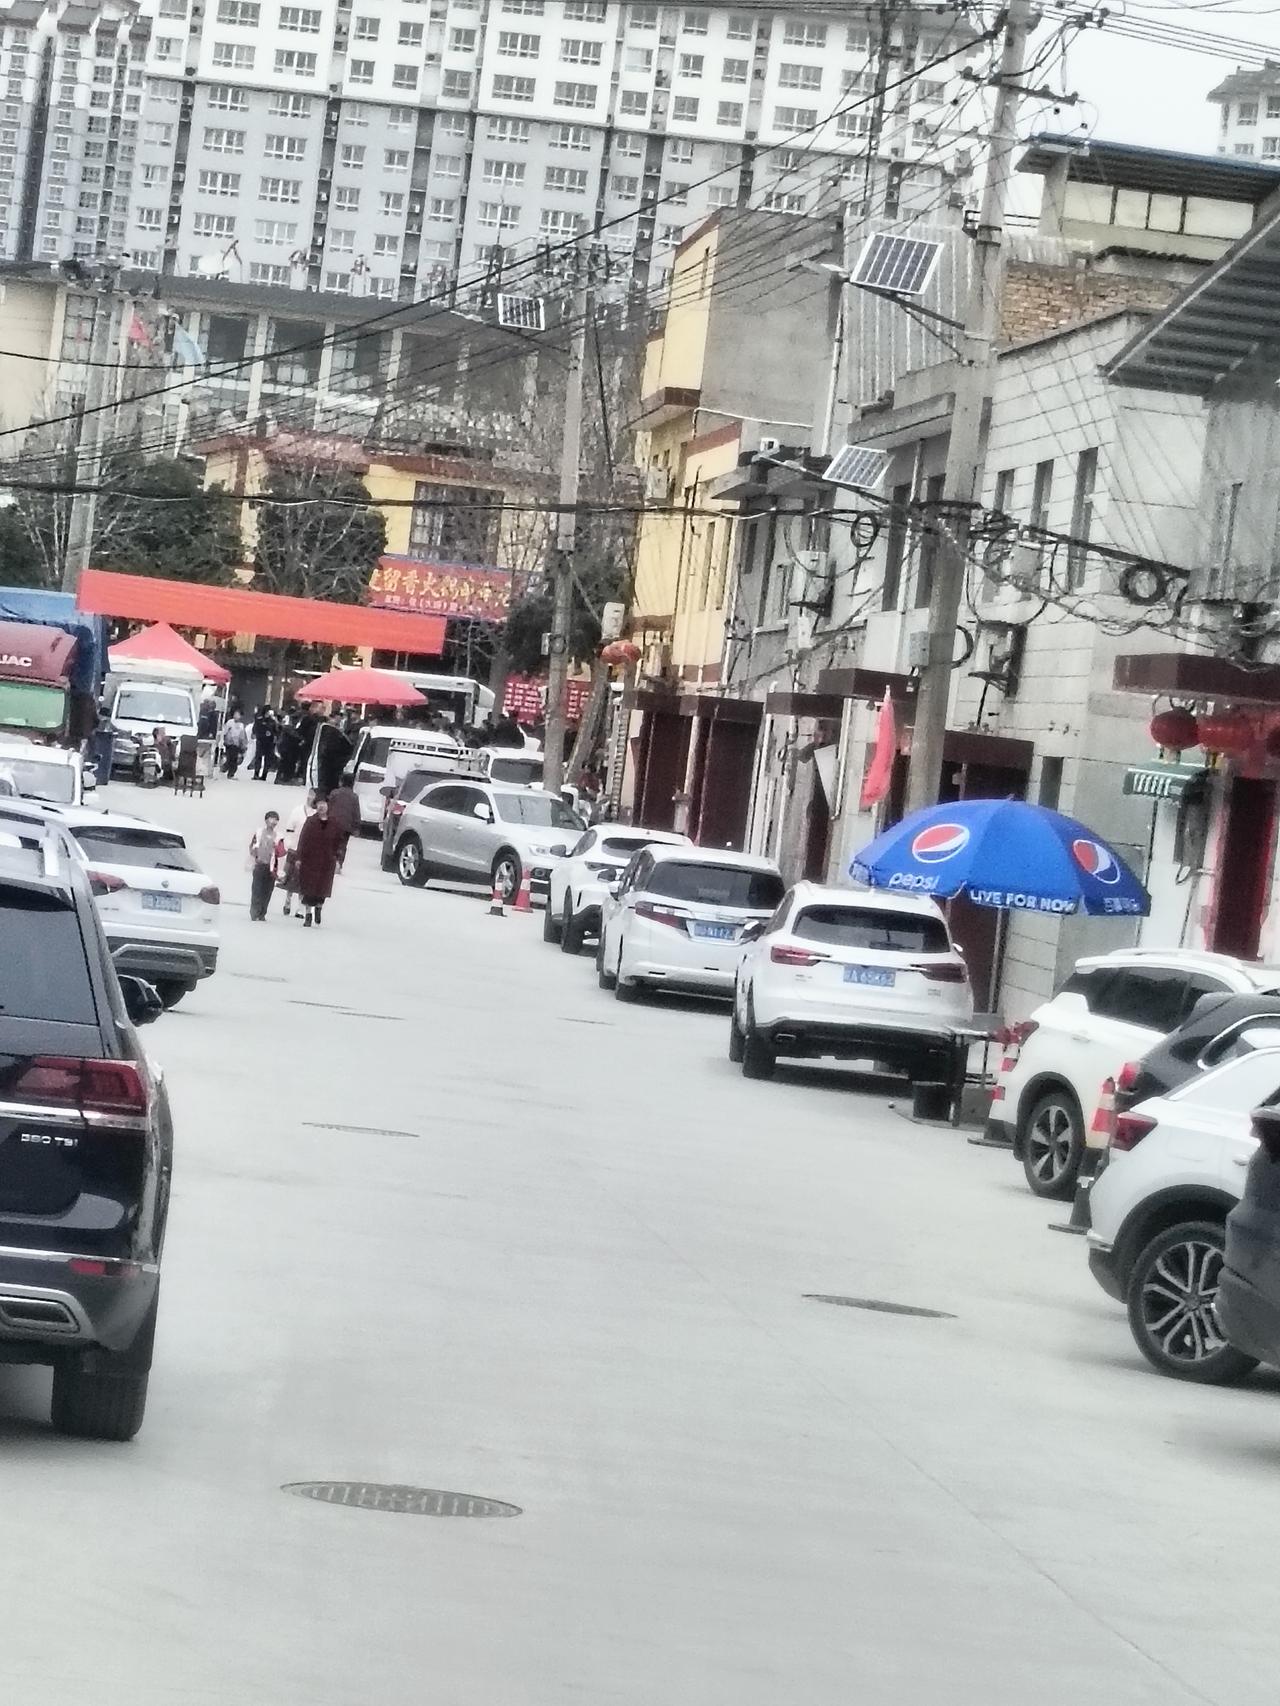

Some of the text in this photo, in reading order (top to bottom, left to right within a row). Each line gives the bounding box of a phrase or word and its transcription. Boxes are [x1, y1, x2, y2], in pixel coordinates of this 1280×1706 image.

[969, 889, 1078, 914] LIVE FOR NOW
